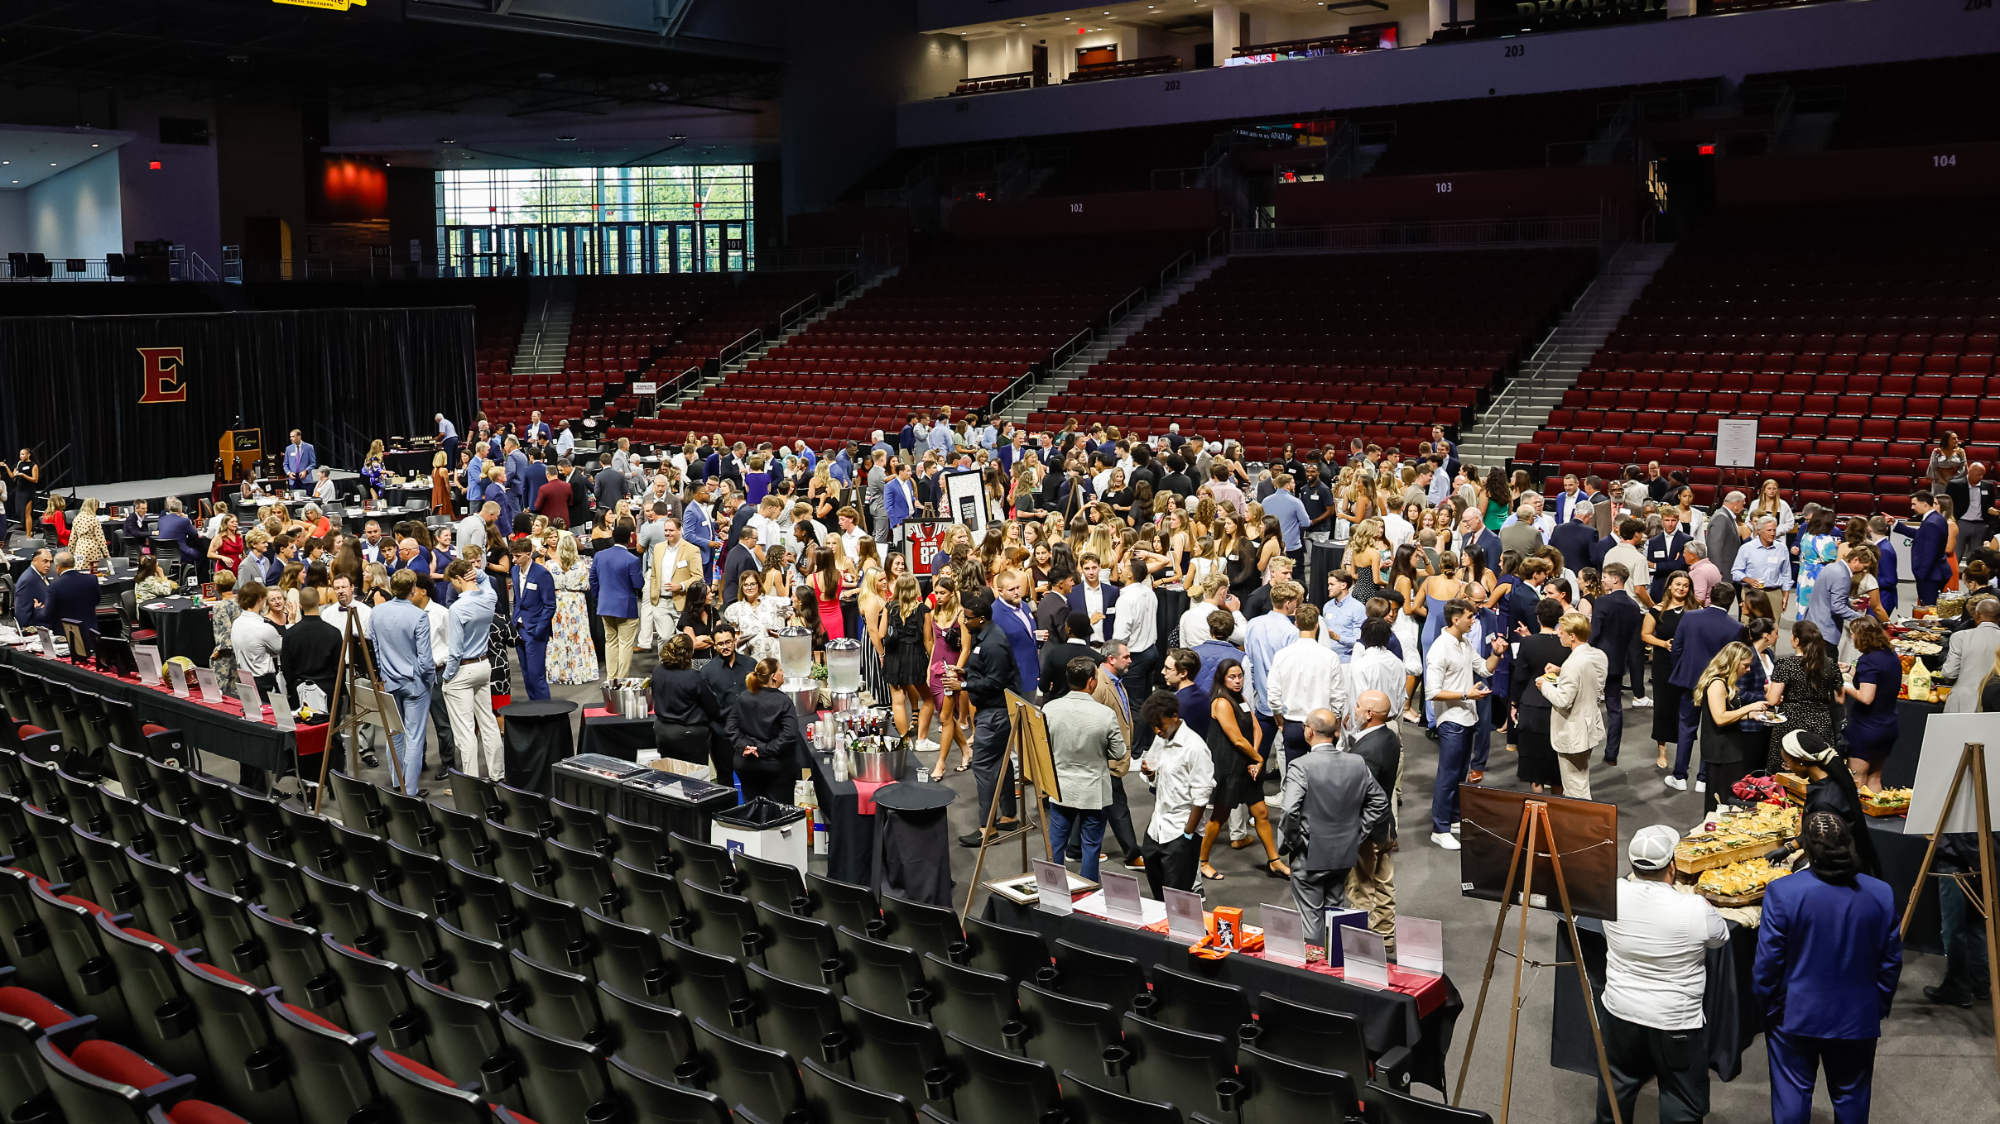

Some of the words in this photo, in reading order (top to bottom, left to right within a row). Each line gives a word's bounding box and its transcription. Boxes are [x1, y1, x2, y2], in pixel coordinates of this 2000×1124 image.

[1505, 44, 1525, 58] 203
[1165, 80, 1181, 91] 202
[955, 102, 969, 113] 201
[1932, 154, 1956, 168] 104
[1435, 181, 1453, 194] 103
[1070, 203, 1083, 213] 102
[727, 240, 740, 249] 101
[374, 247, 388, 256] 101
[136, 346, 187, 404] E
[201, 582, 216, 599] E
